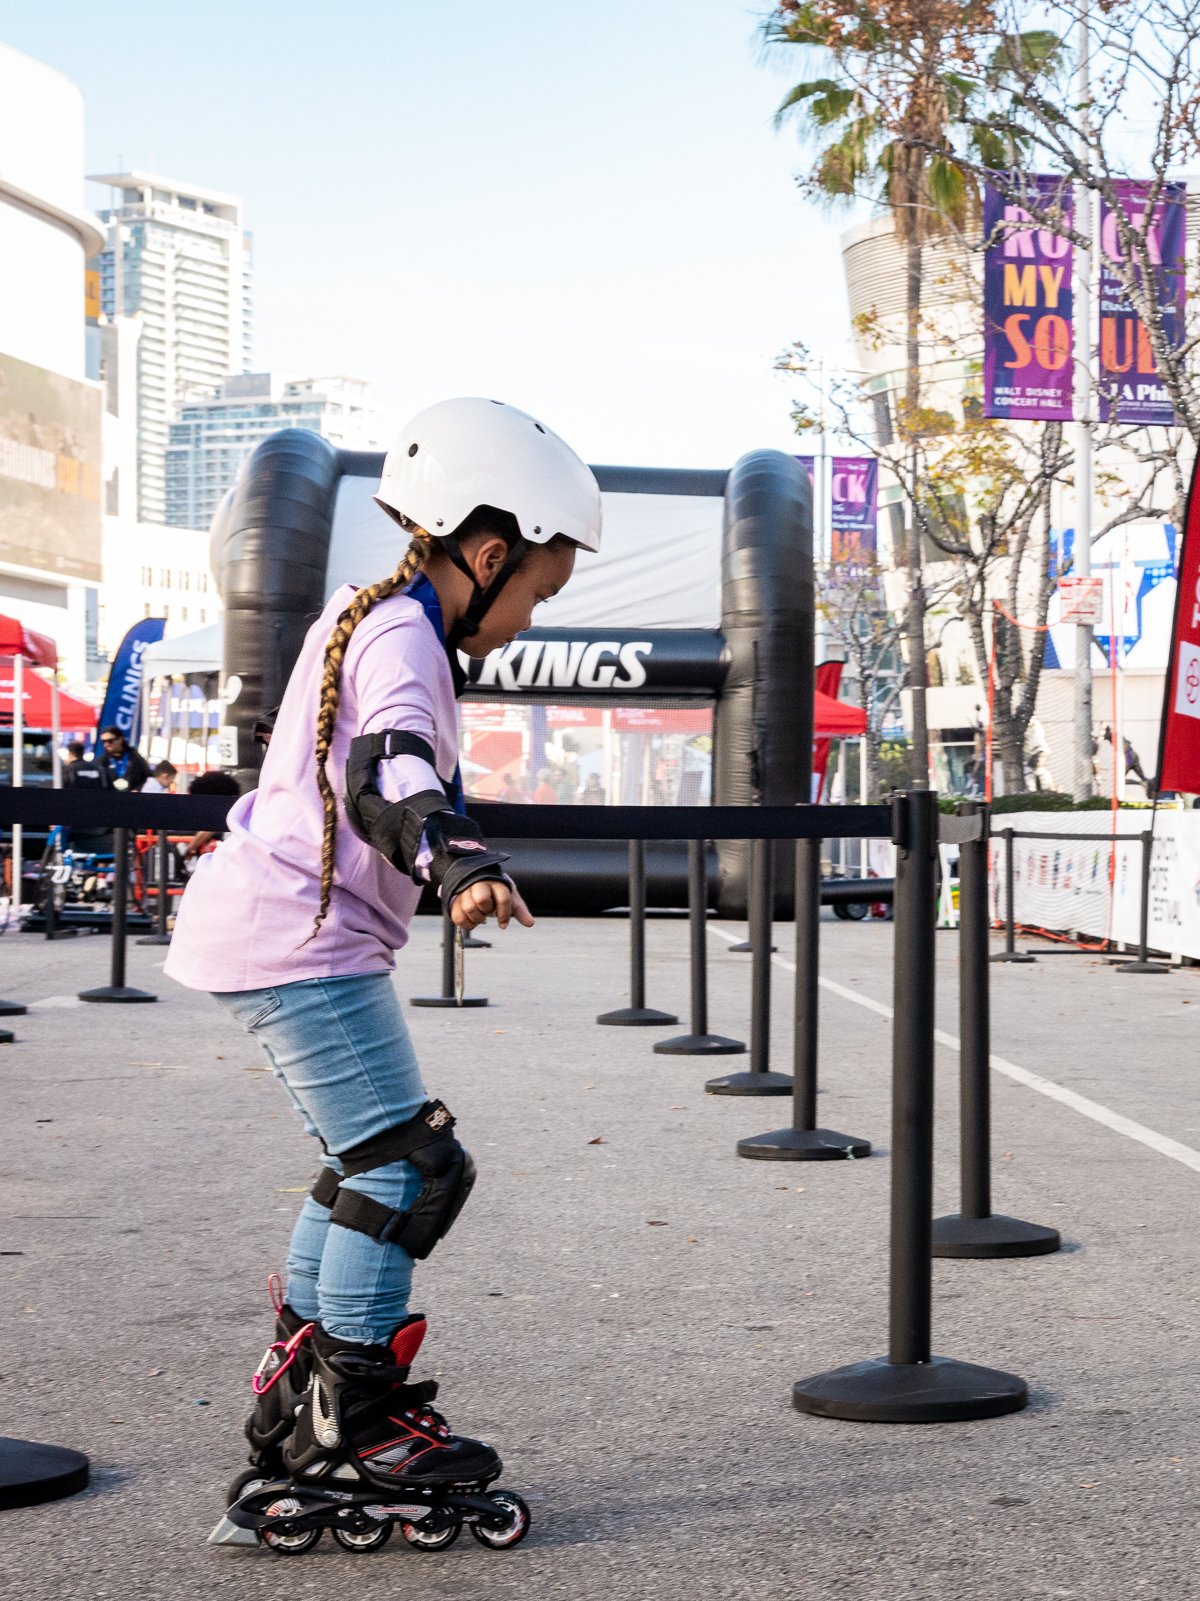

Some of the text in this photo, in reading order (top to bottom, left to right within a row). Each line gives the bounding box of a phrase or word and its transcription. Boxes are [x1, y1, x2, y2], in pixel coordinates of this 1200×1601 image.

[1004, 263, 1065, 308] MY
[115, 639, 150, 730] CLINICS
[477, 640, 653, 691] KINGS
